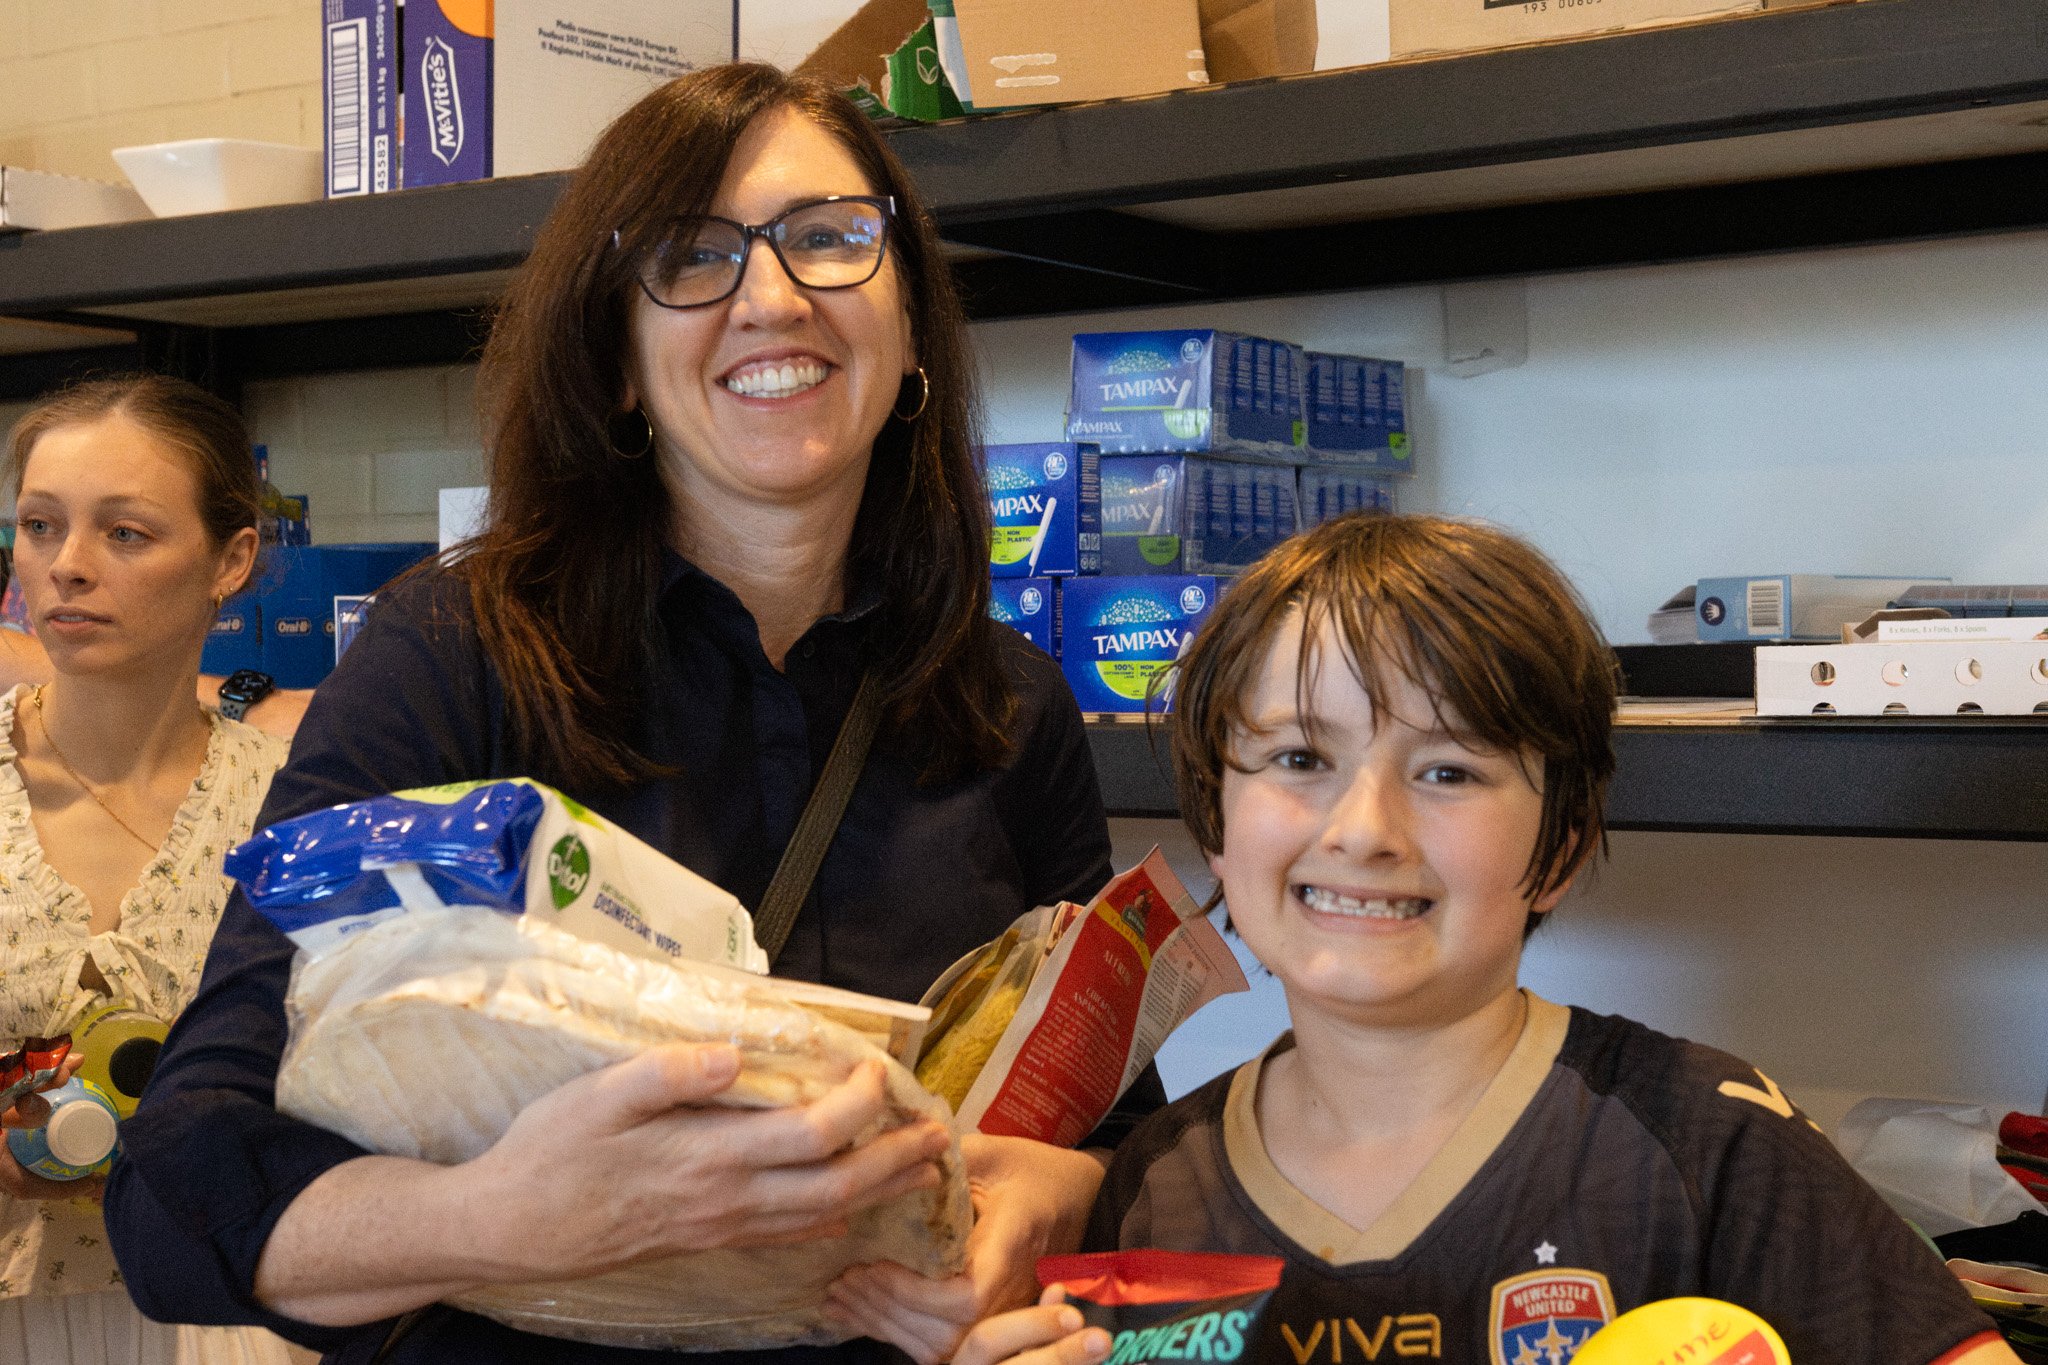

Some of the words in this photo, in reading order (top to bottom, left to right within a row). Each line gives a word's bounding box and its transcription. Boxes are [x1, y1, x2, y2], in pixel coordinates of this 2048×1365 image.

[1523, 2, 1547, 14] 193
[427, 53, 457, 148] McVitie's
[376, 139, 387, 188] 45582
[1099, 375, 1179, 402] TAMPAX
[1102, 502, 1151, 523] MPAX
[1092, 627, 1179, 655] TAMPAX
[1114, 663, 1134, 671] 100%
[654, 929, 682, 958] WIPES
[1512, 1283, 1591, 1309] NEWCASTLE
[1525, 1299, 1577, 1318] UNITED
[1104, 1309, 1249, 1365] ORNERS
